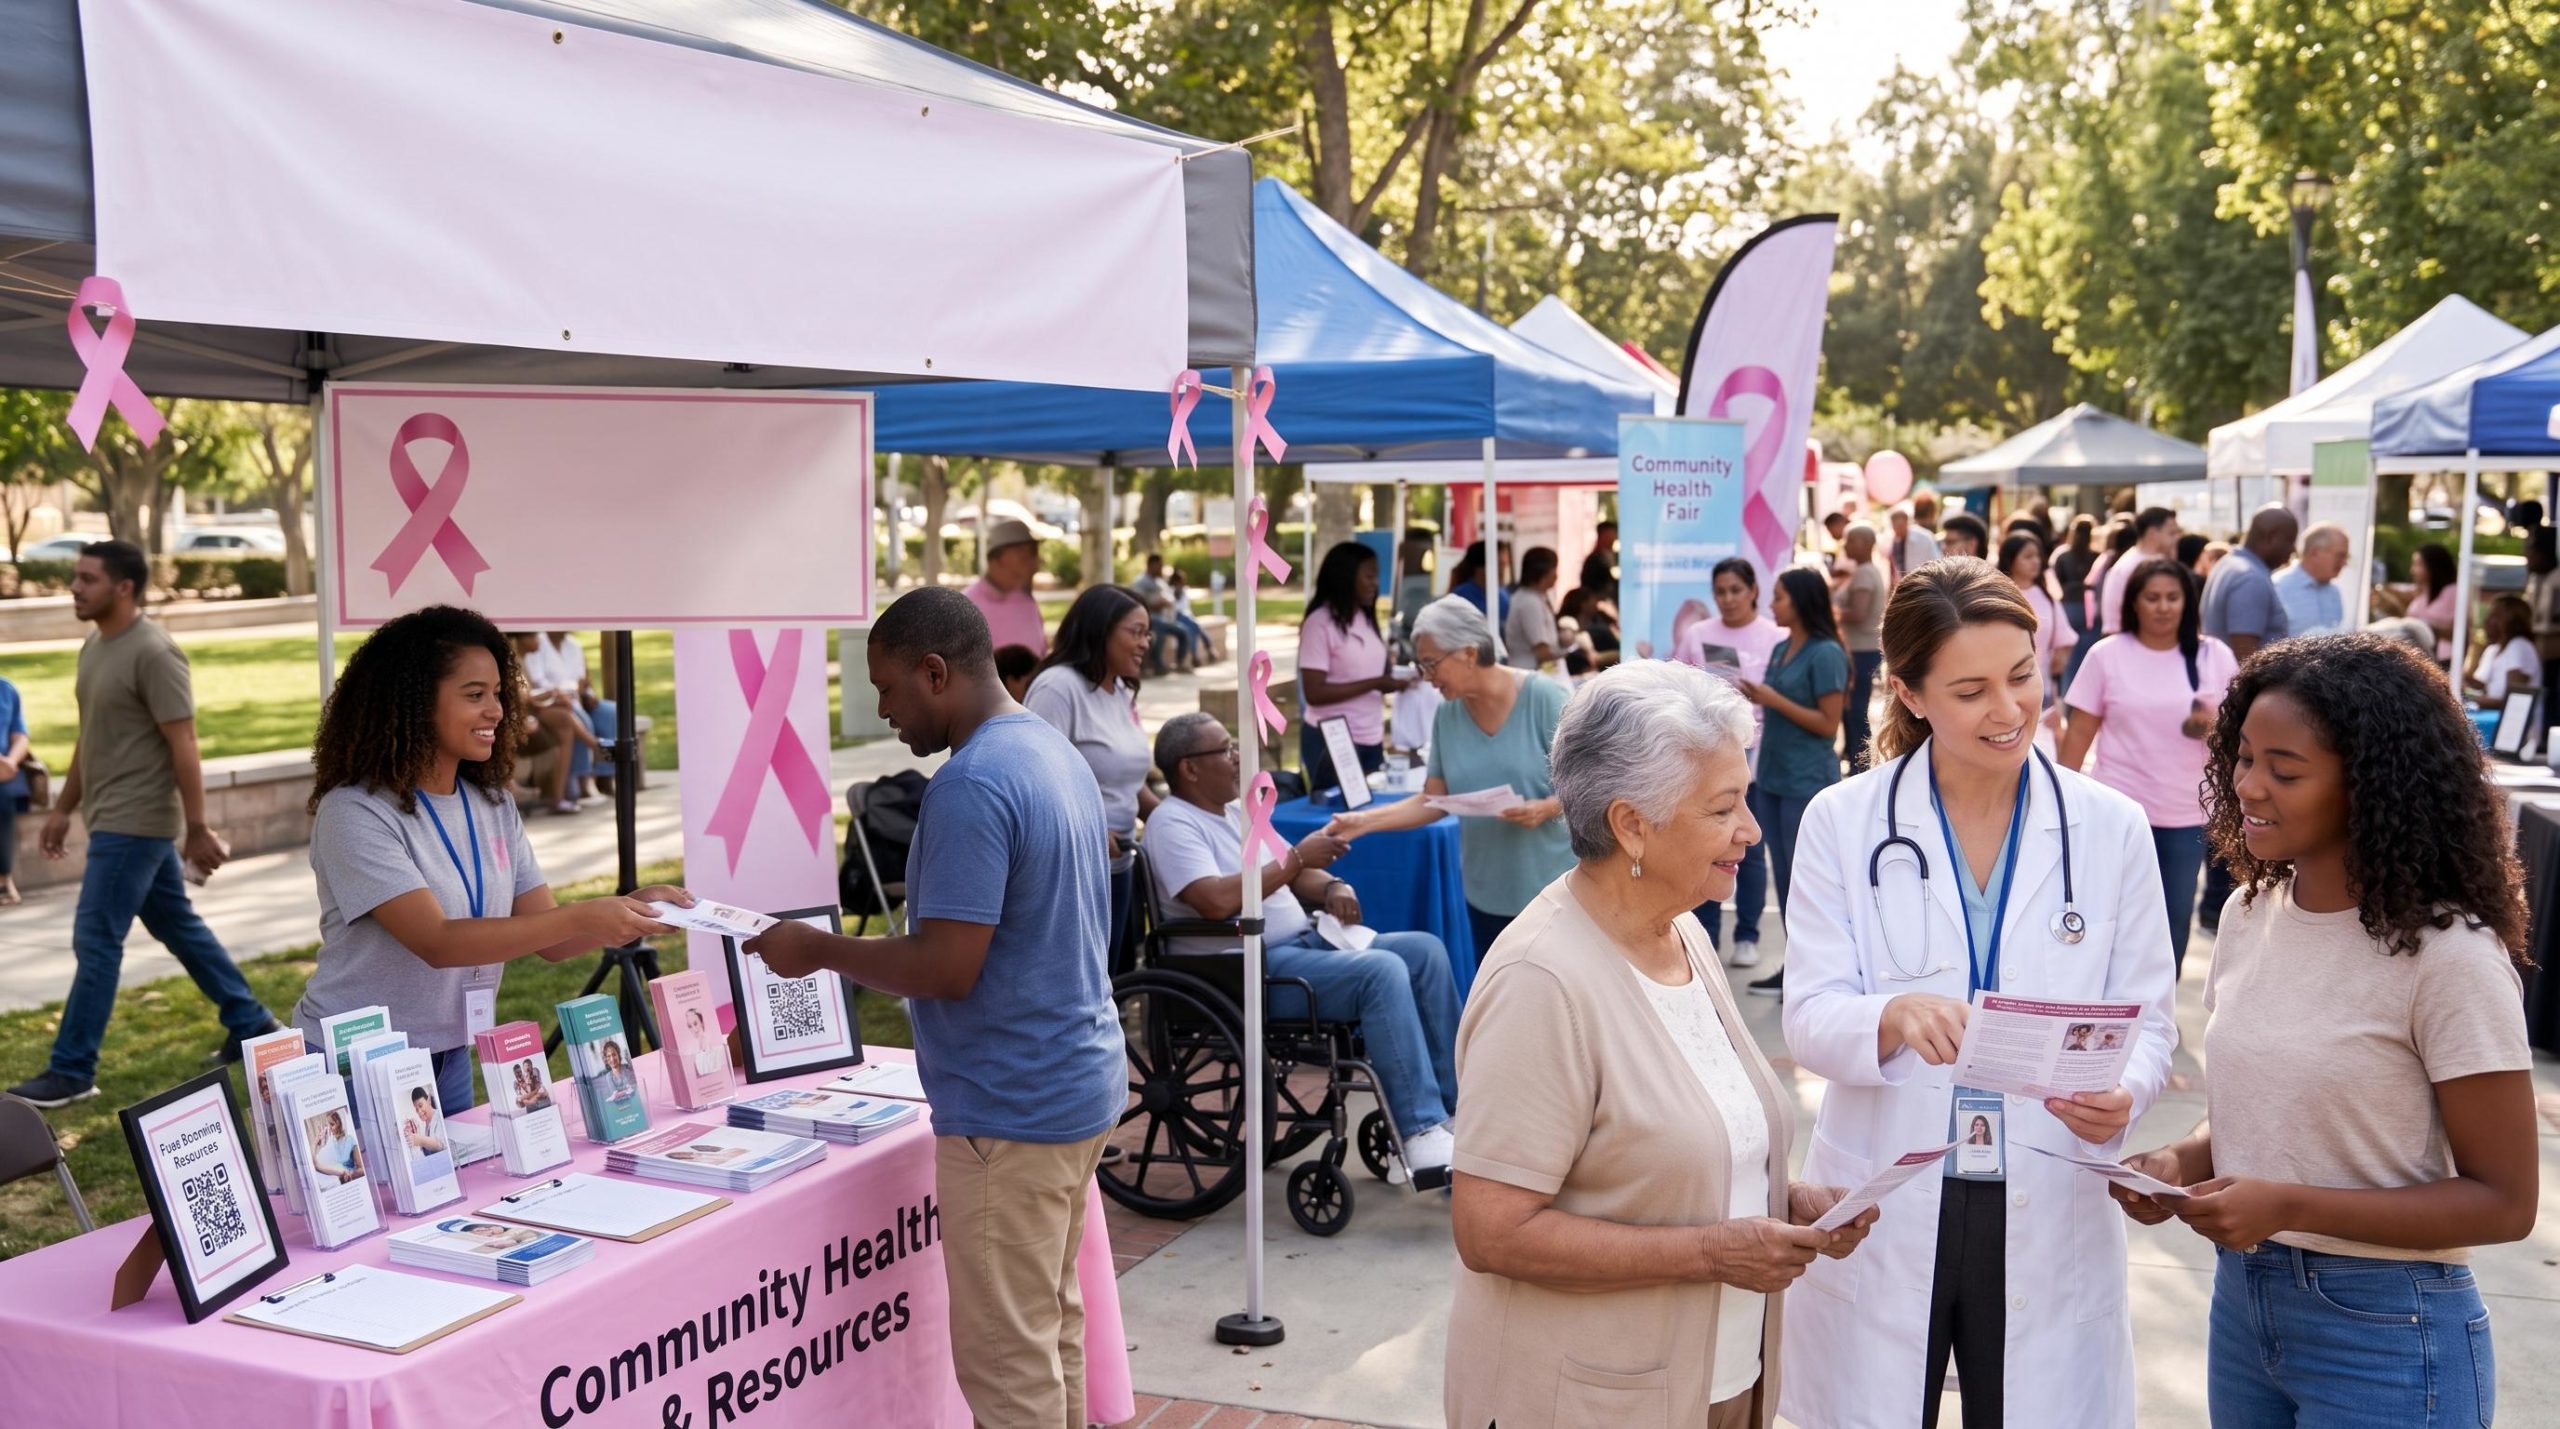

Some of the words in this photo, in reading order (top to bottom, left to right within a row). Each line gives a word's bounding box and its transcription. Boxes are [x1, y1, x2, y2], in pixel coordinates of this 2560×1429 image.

[1632, 455, 1732, 478] Community
[1653, 479, 1712, 498] Health
[1666, 503, 1701, 521] Fair
[173, 1141, 219, 1169] Resources
[540, 1264, 812, 1429] Community
[824, 1194, 942, 1296] Health
[662, 1393, 693, 1429] &
[707, 1290, 911, 1429] Resources
